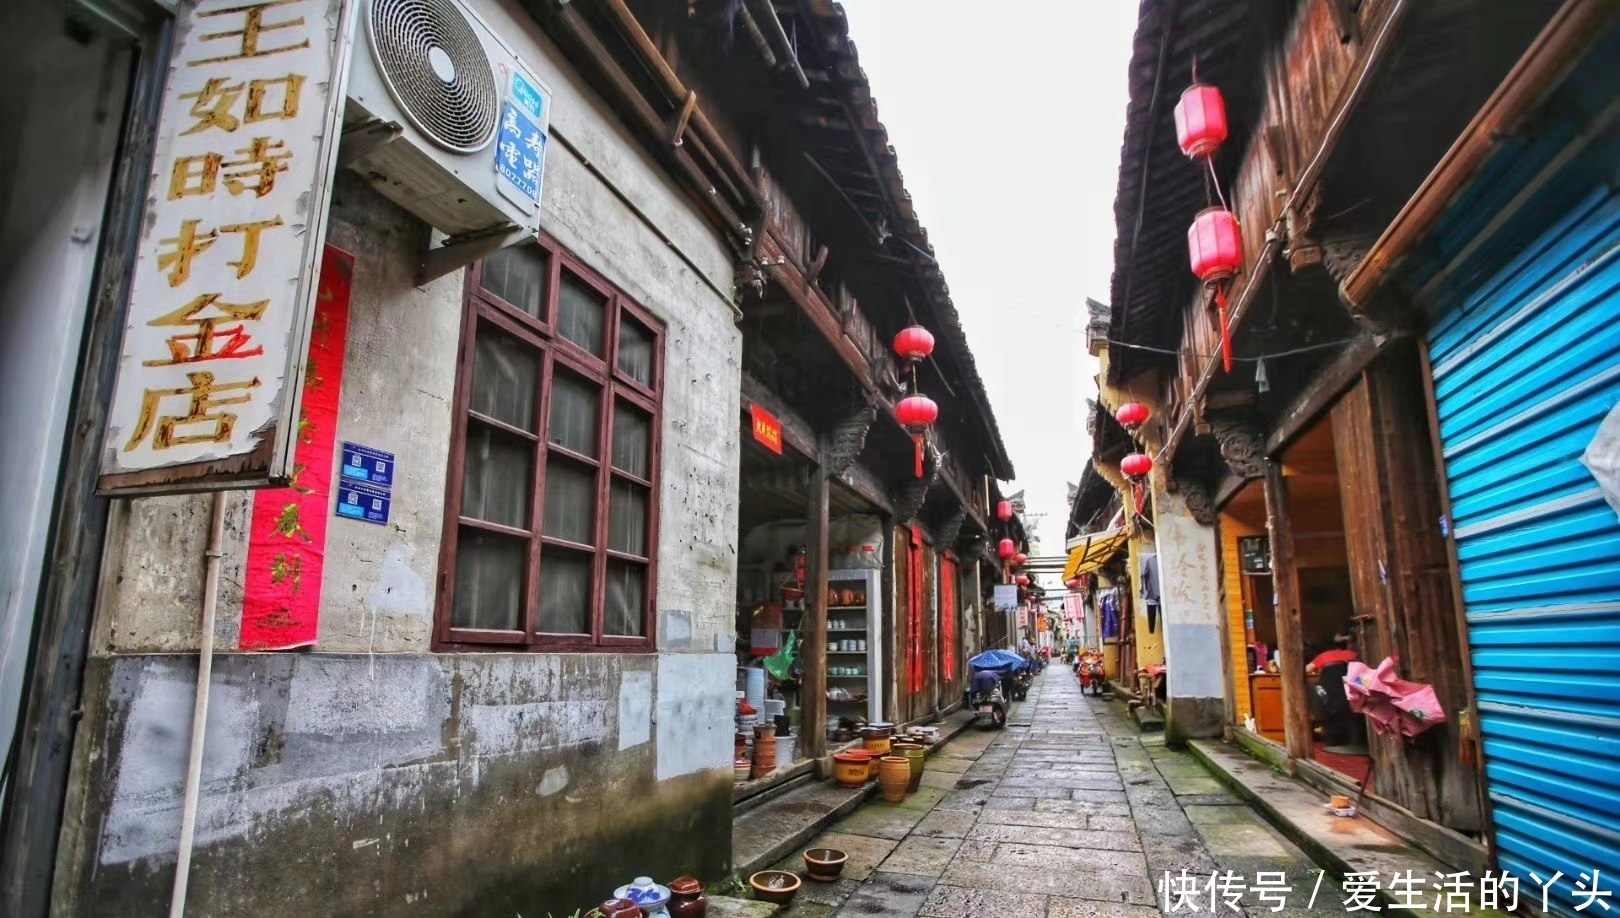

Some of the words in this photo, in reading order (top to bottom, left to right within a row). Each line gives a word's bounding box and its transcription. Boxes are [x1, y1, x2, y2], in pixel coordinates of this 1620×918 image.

[123, 2, 311, 452] 王如時打金店
